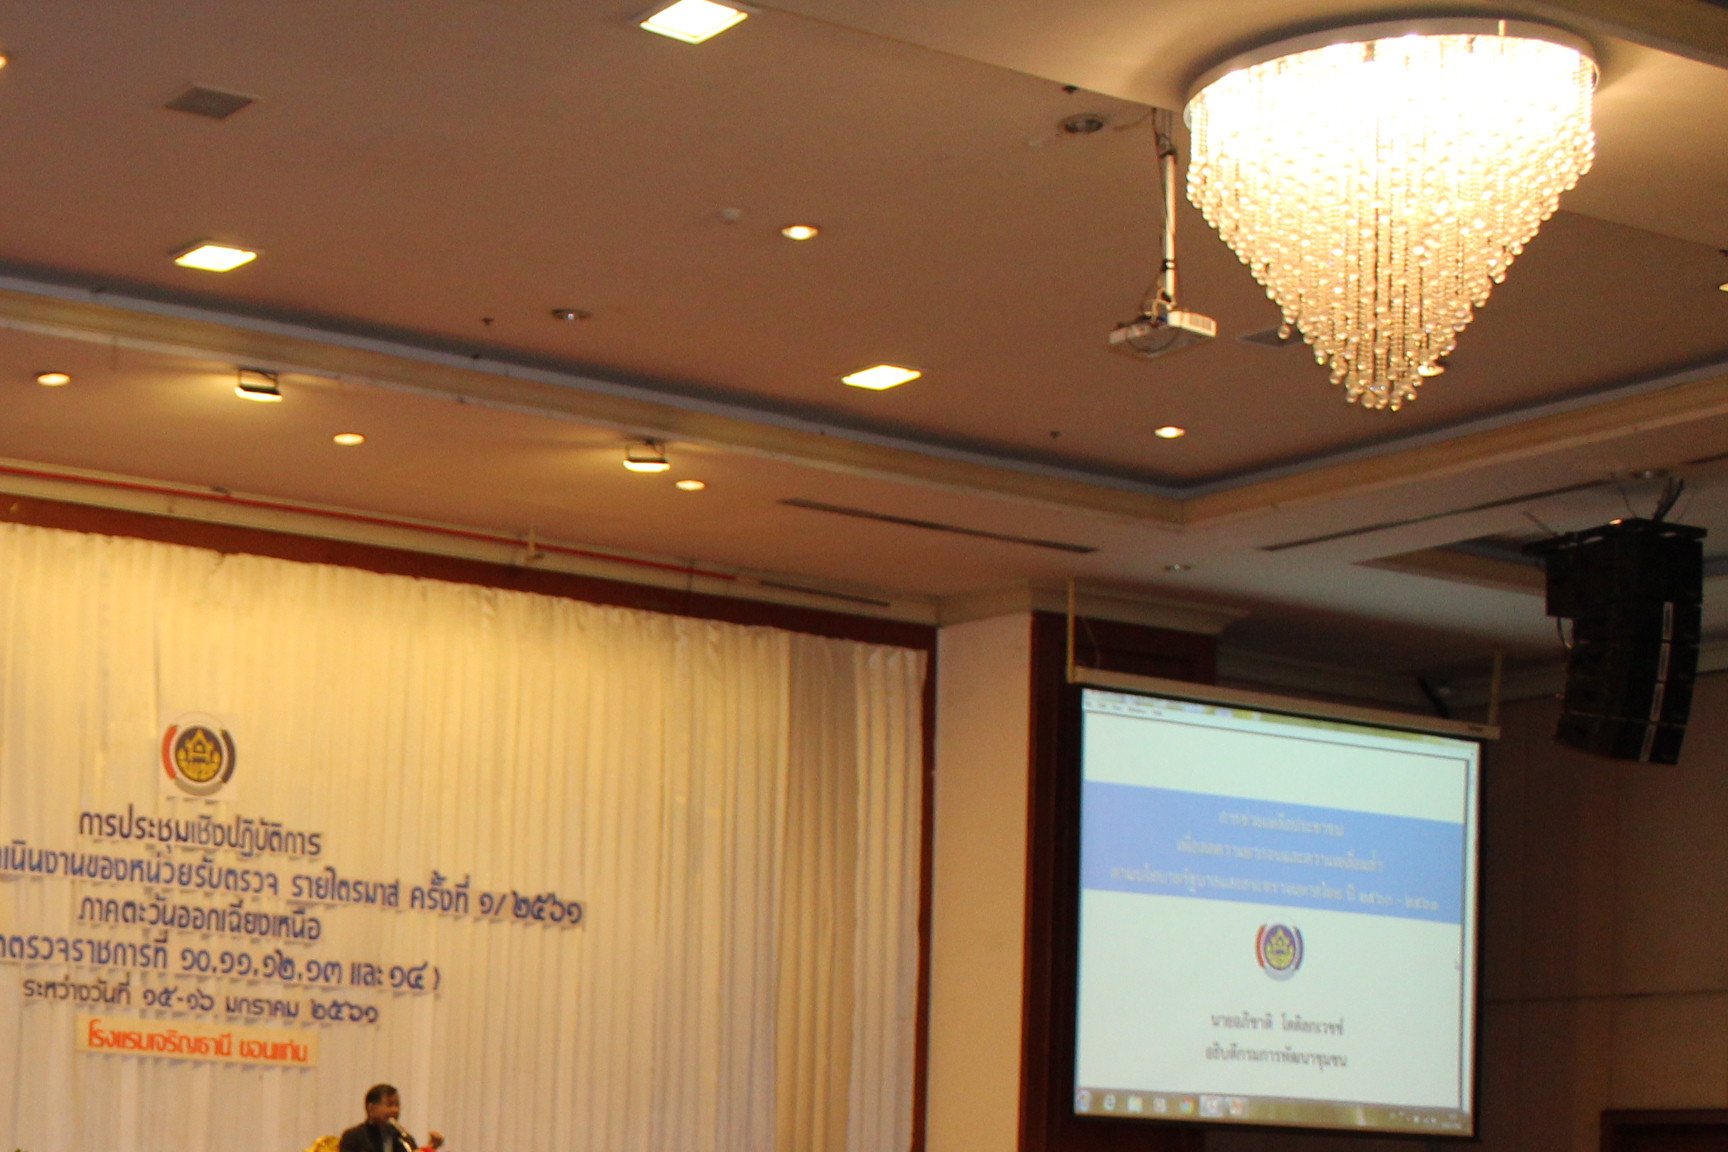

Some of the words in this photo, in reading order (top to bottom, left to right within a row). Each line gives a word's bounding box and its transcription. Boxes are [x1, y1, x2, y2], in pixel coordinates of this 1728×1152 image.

[79, 803, 321, 858] การประชุมเชิงปฏิบัติการ
[292, 866, 401, 907] รายไตรมาส
[410, 870, 471, 915] ครั้งที่
[77, 895, 321, 940] ภาคตะวันออกเฉียงเหนือ
[23, 971, 131, 1005] ระหว่างวันที่
[225, 996, 300, 1018] มกราคม
[310, 997, 380, 1024] ๒๕๖๑
[350, 961, 384, 987] และ
[88, 1018, 232, 1057] โรงแรมเจริญธานี
[239, 1036, 308, 1062] ขอนแก่น
